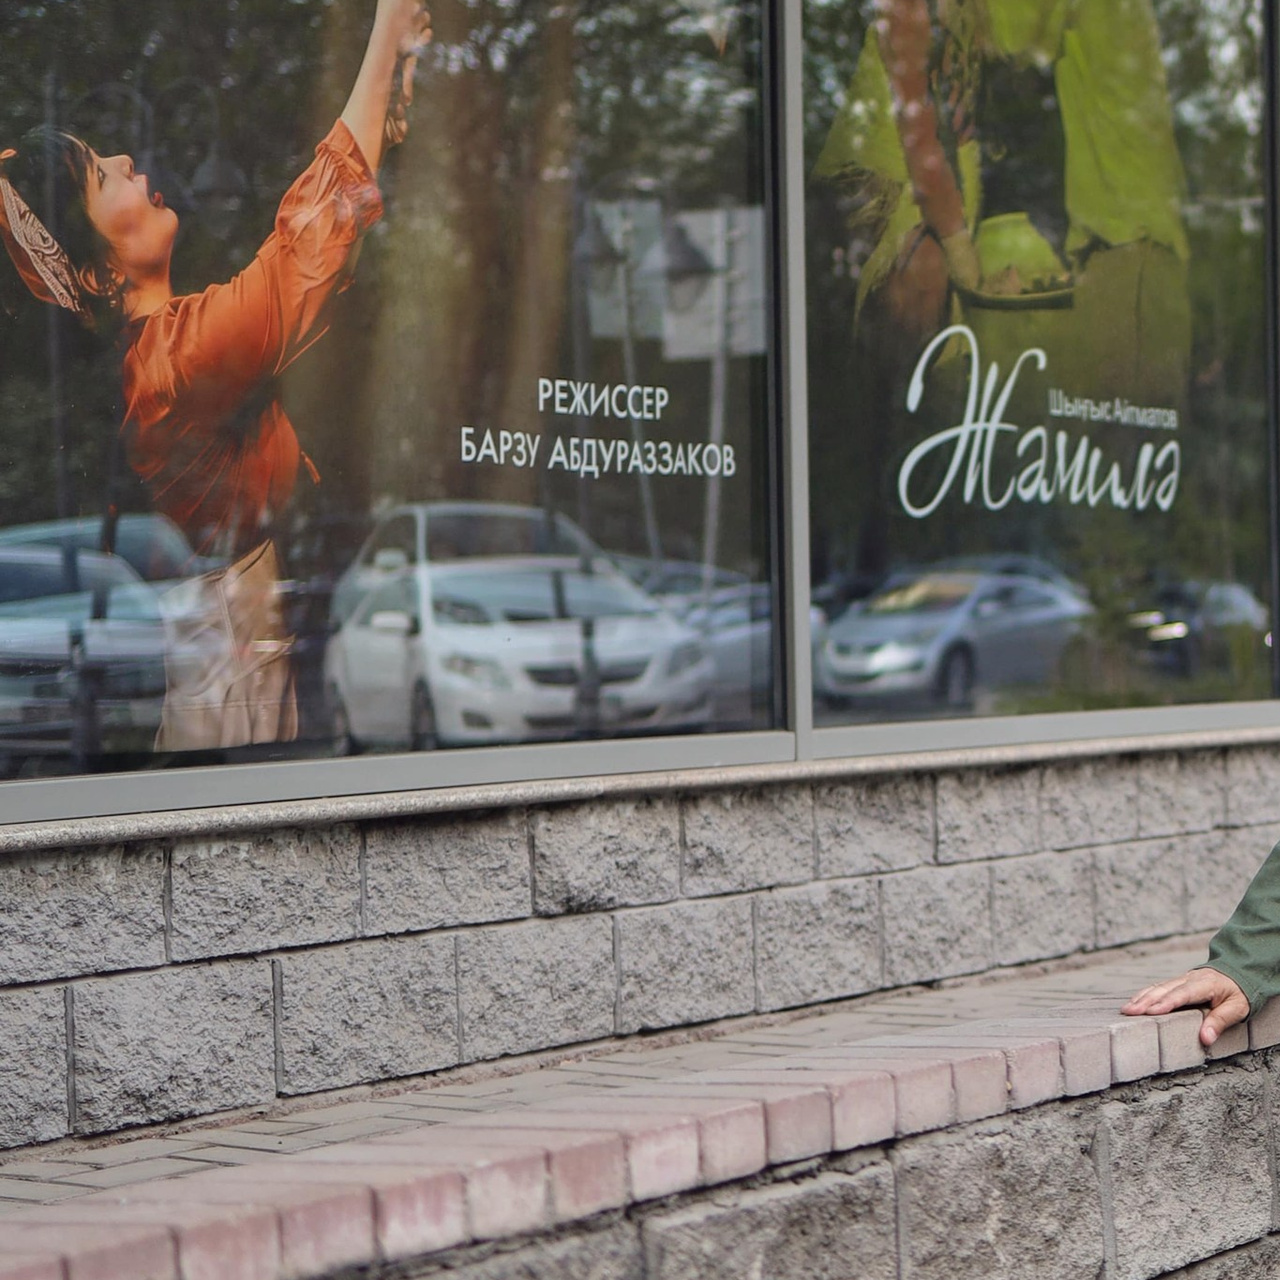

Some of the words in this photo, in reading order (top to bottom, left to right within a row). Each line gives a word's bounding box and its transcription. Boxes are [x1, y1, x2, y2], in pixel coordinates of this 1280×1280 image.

[538, 377, 669, 420] РЕЖИССЕР
[460, 426, 541, 469] БАРЗУ
[547, 435, 737, 480] АБДУРАЗЗАКОВ
